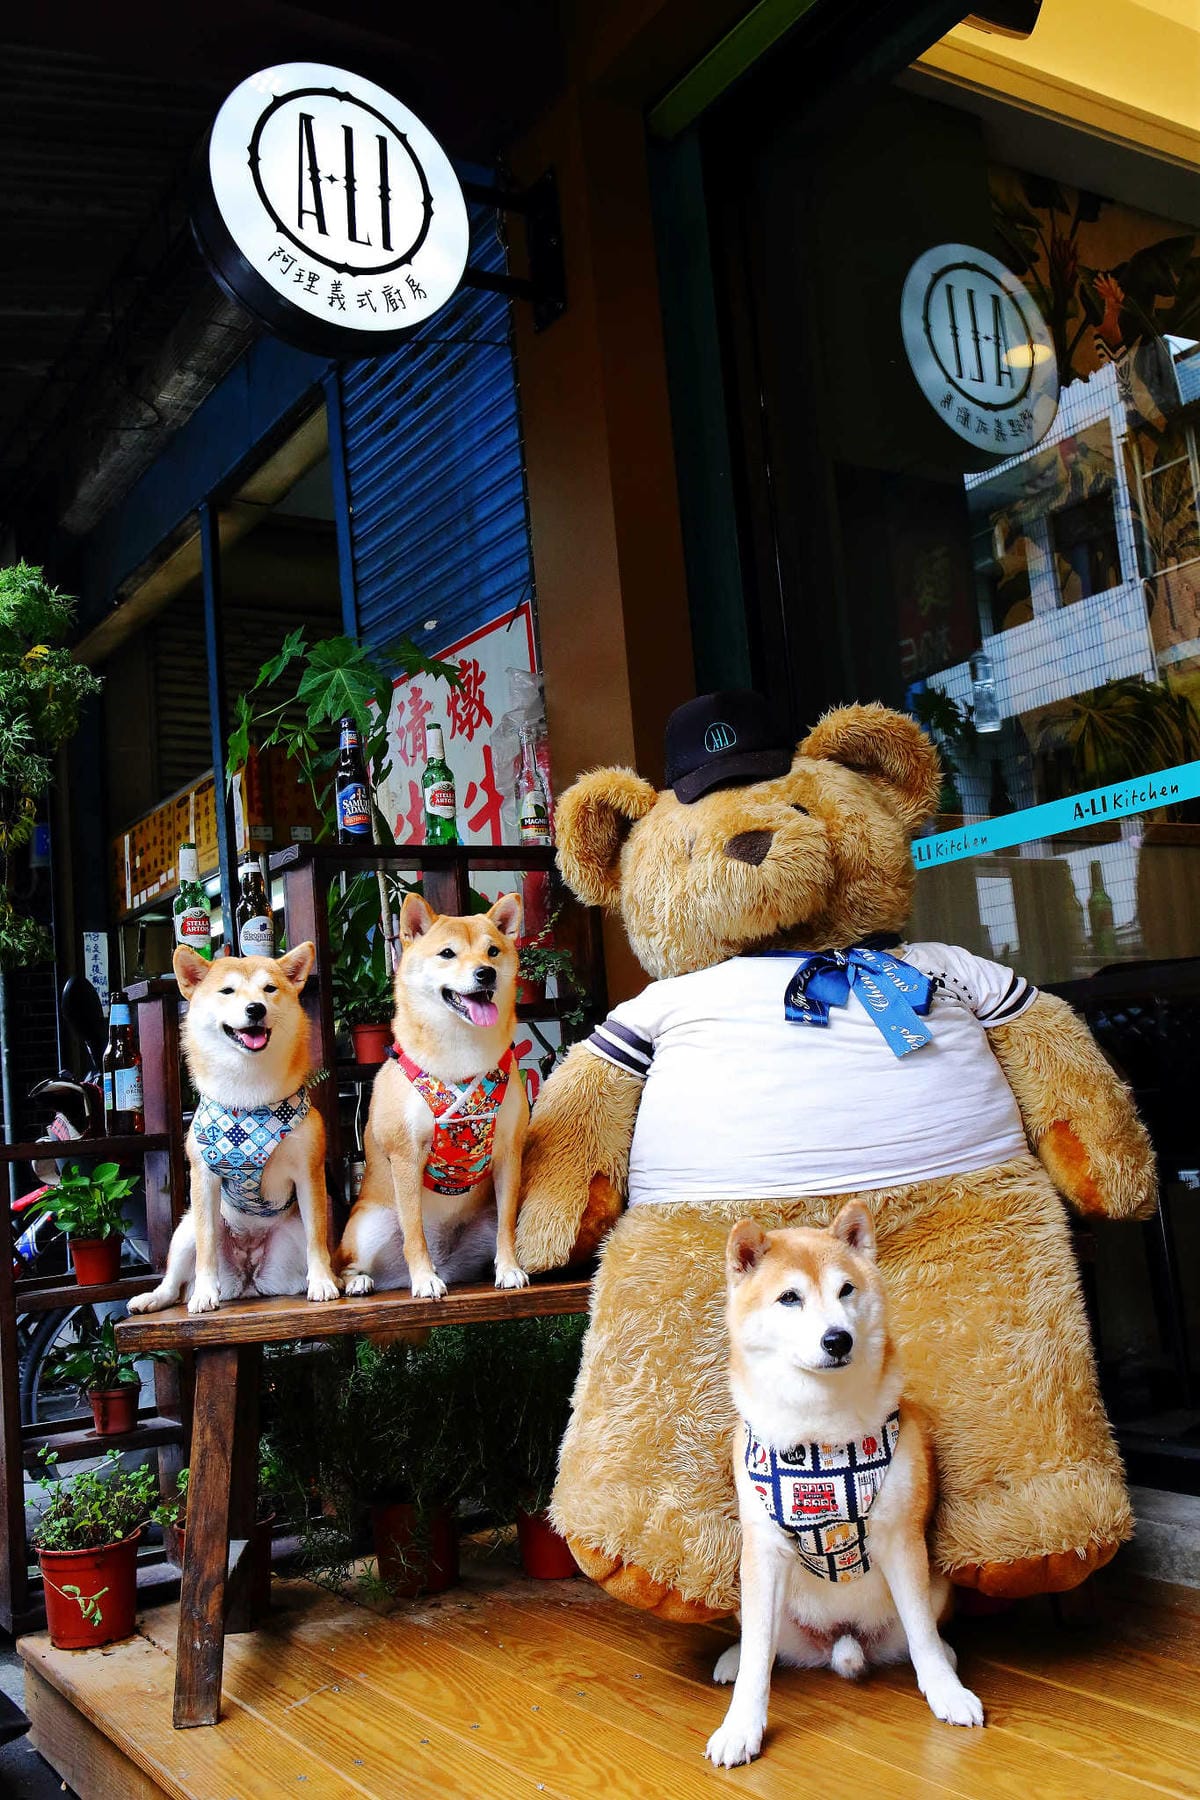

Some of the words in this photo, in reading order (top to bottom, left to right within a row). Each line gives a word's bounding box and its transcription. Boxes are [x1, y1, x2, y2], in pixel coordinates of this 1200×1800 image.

[268, 246, 427, 312] 阿理義式廚房
[1073, 795, 1108, 821] A-LI
[1112, 782, 1179, 810] Kitchen
[913, 843, 931, 863] -LI
[935, 833, 988, 858] Kitchen
[763, 1462, 769, 1473] 3
